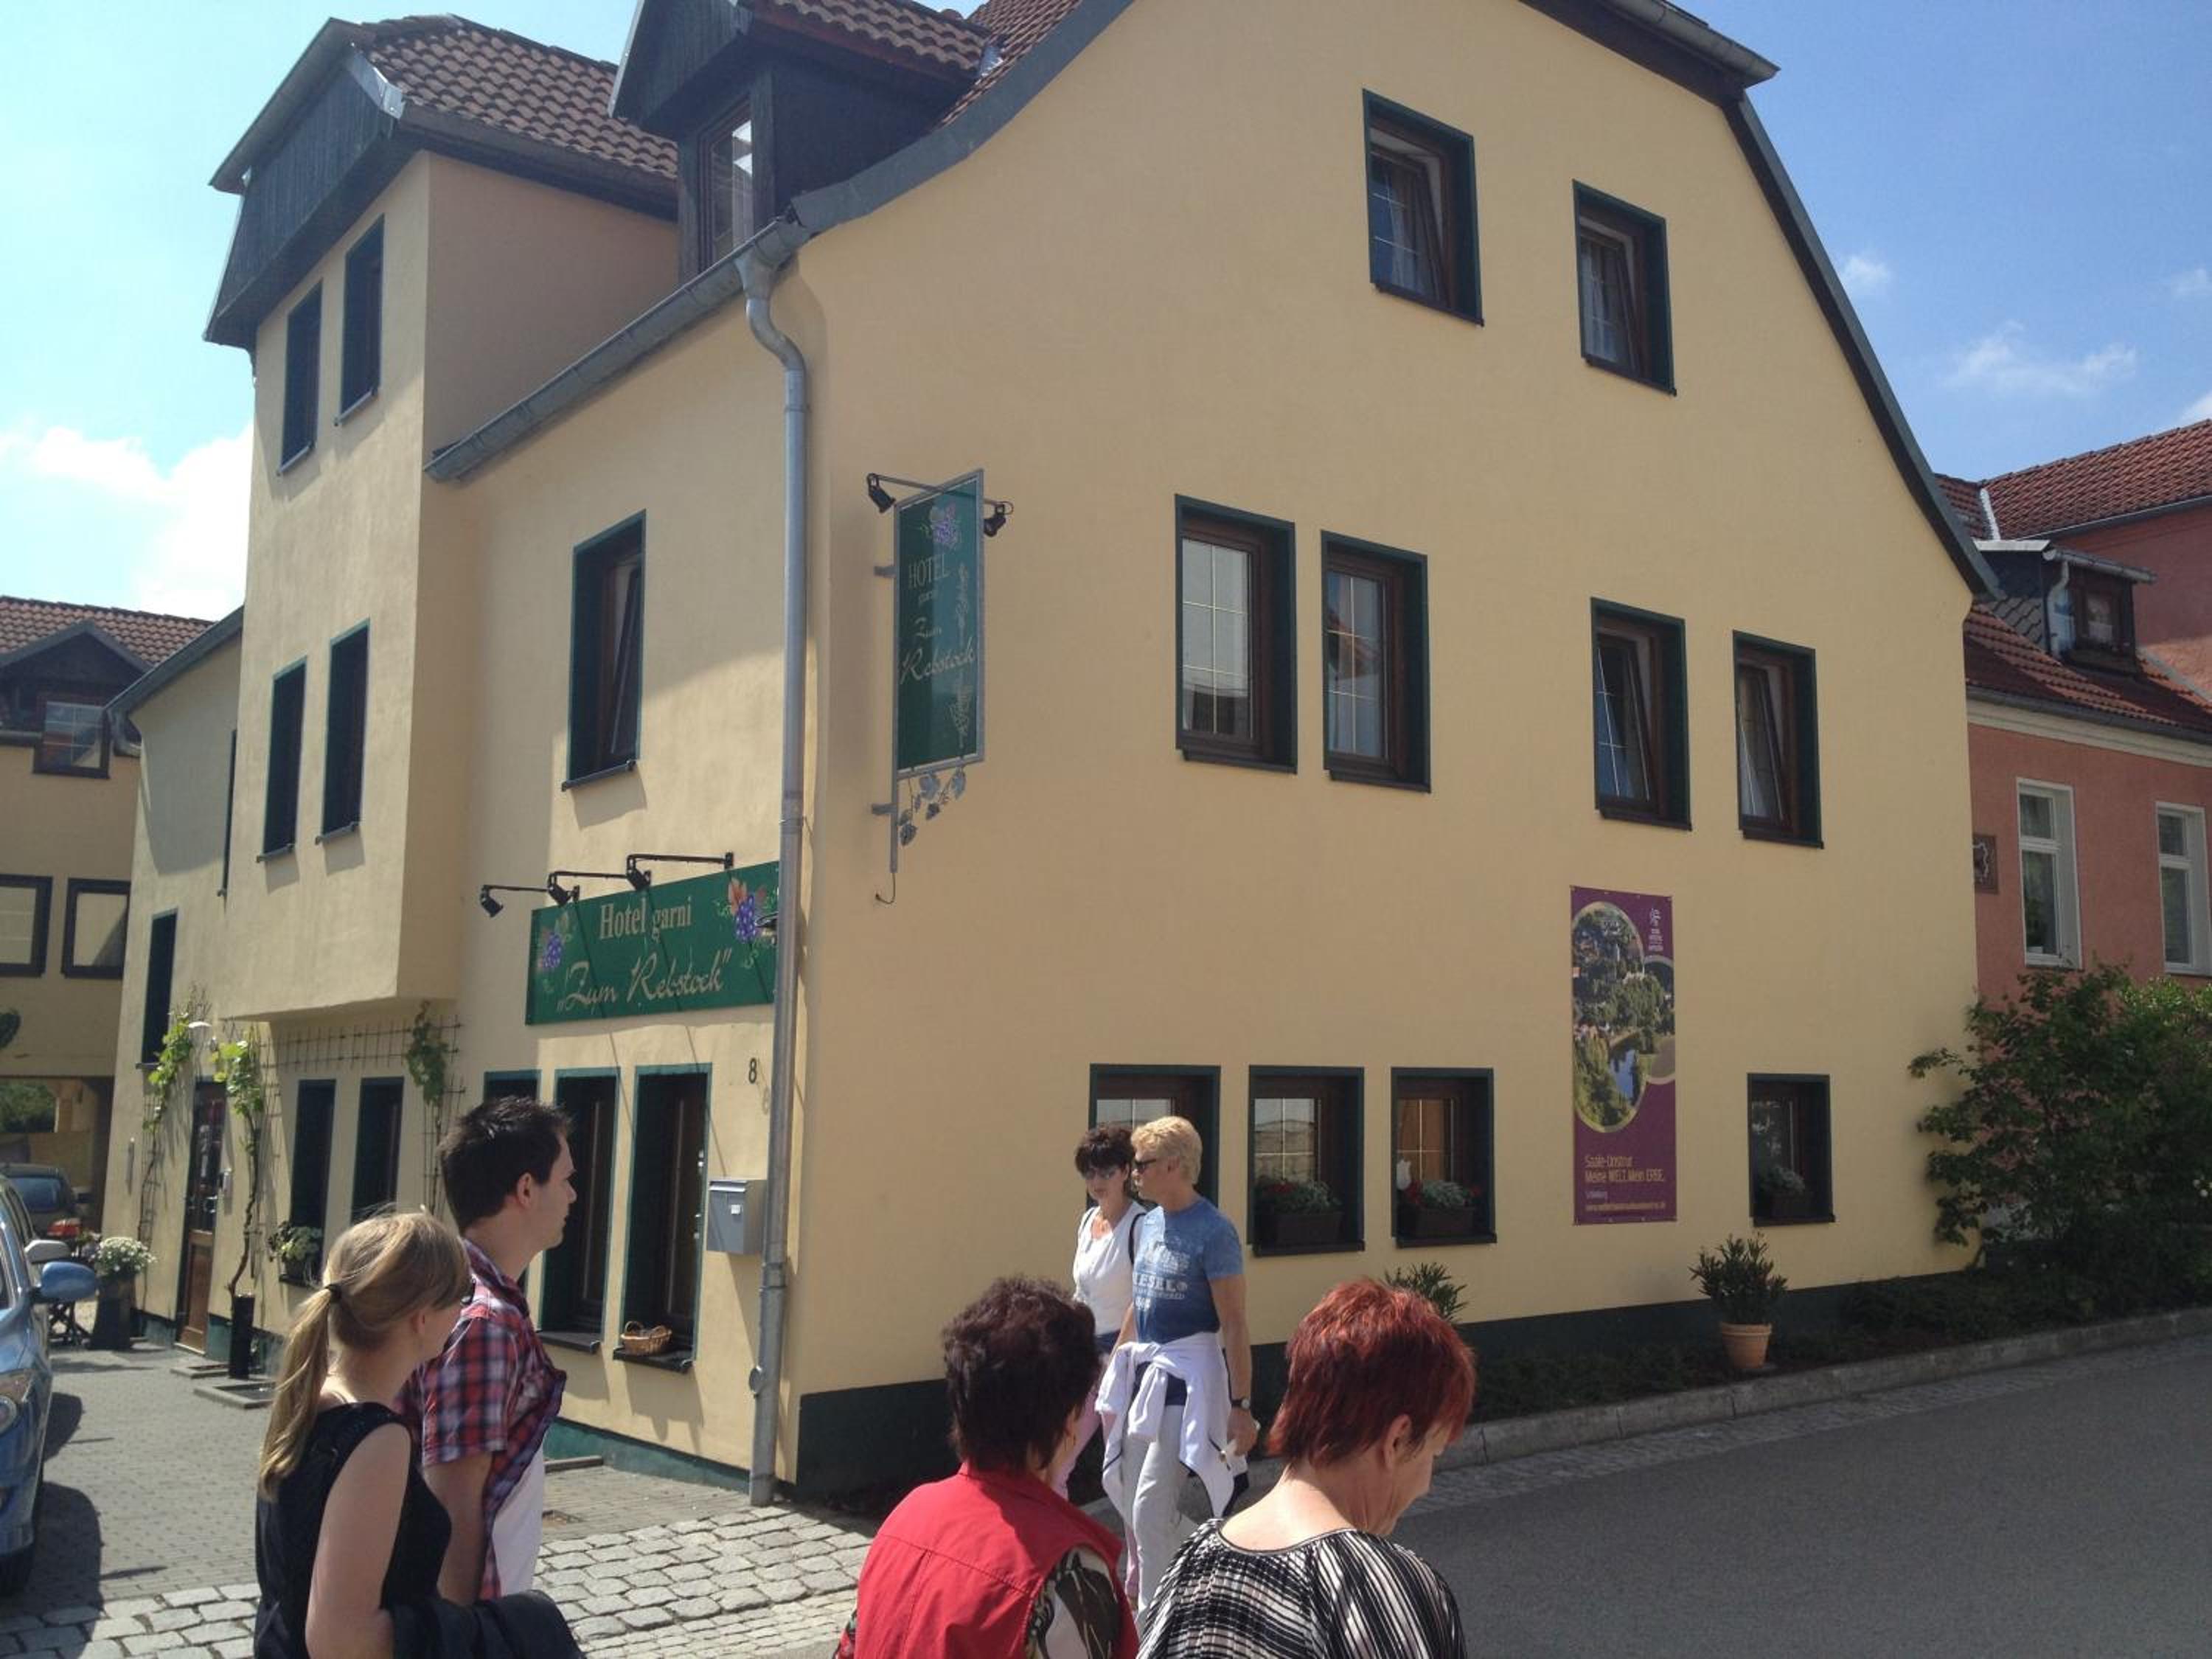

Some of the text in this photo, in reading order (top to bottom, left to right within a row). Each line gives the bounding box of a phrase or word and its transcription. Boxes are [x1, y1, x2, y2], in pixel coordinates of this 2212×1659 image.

[908, 552, 950, 589] HOTEL
[599, 895, 692, 944] Hotel garni
[748, 1057, 758, 1085] 8
